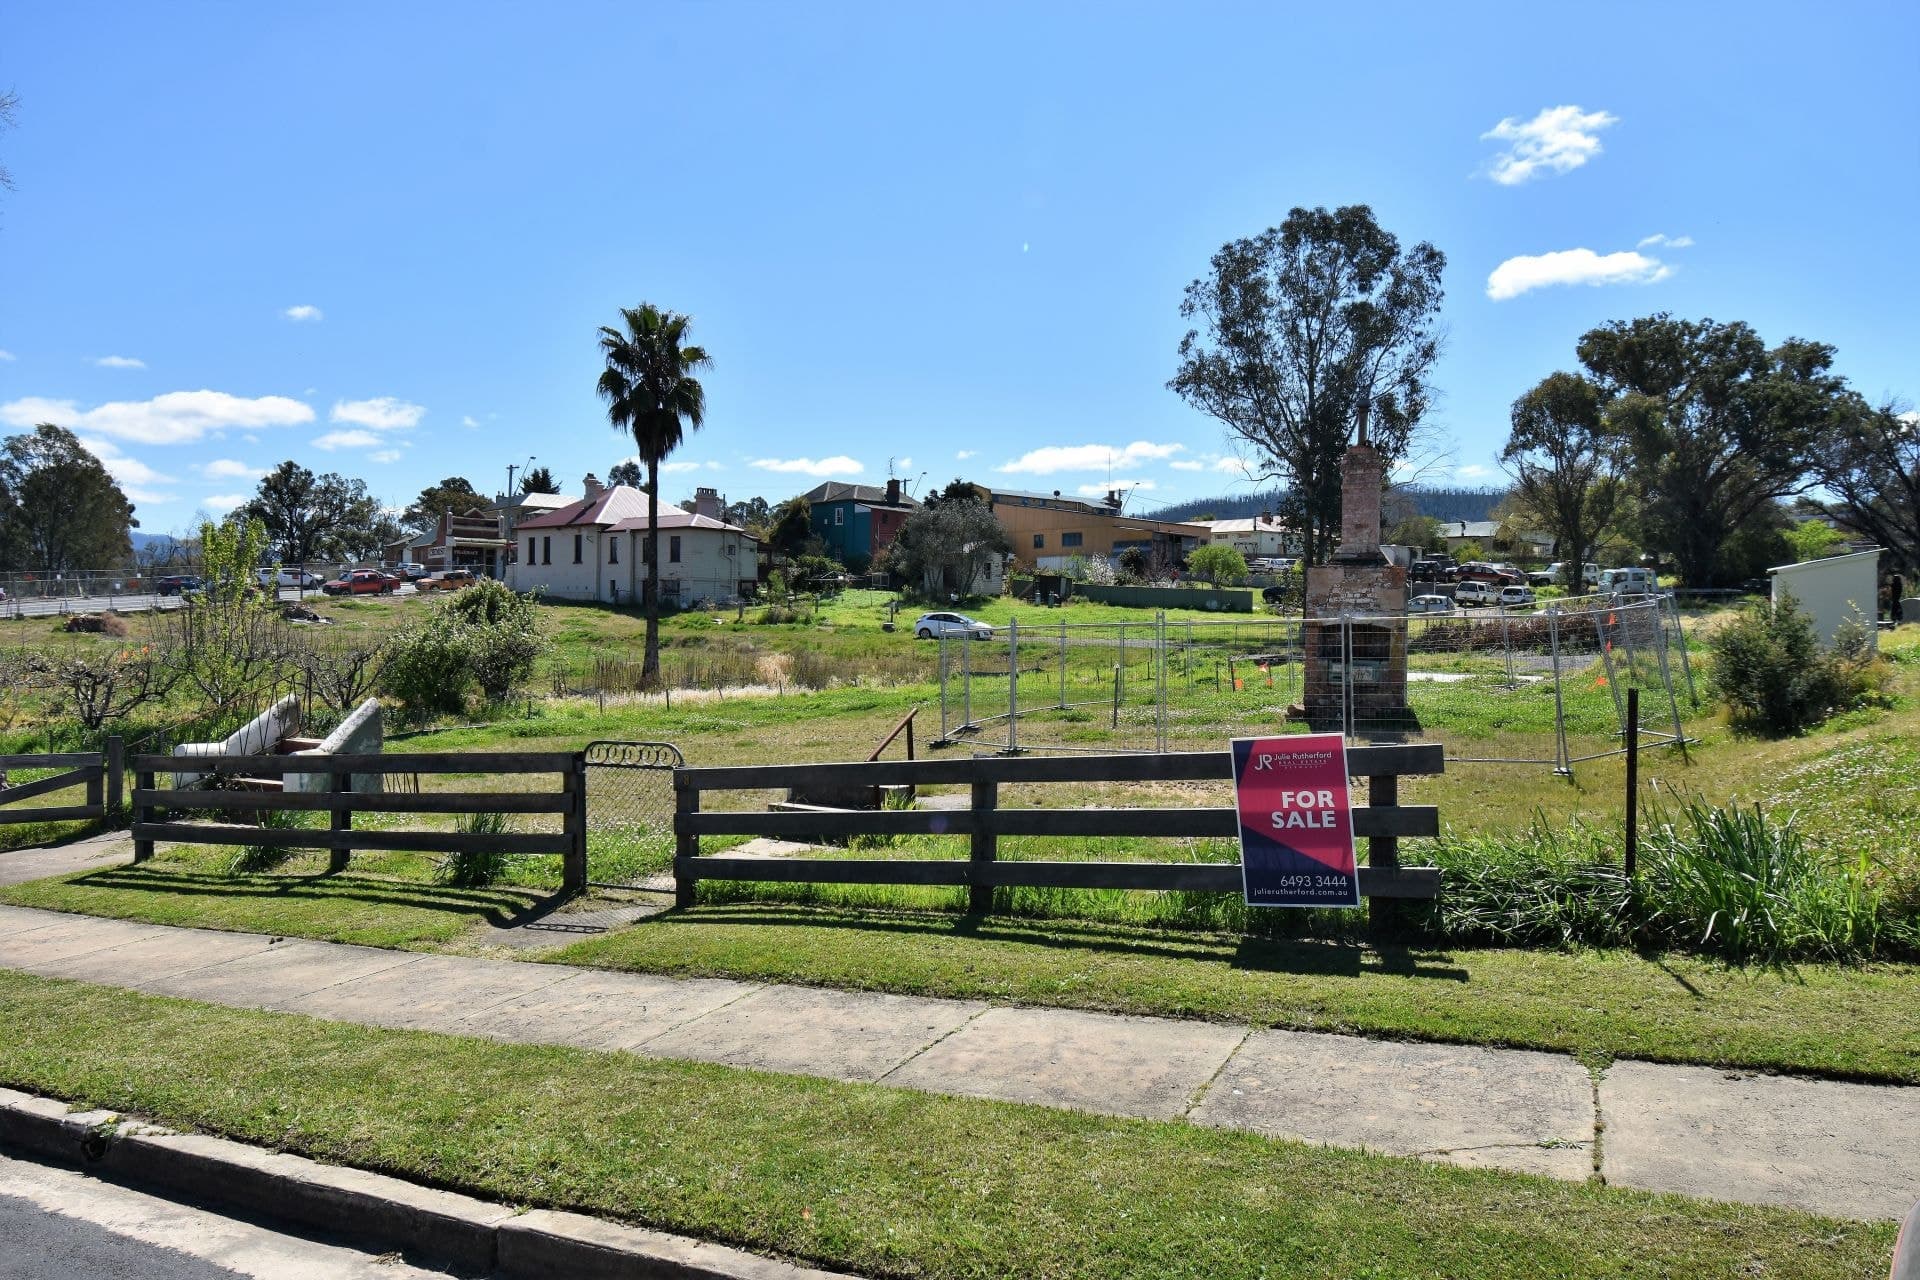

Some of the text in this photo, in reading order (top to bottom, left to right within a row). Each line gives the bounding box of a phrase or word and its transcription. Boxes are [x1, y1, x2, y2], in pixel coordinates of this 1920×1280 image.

[1254, 754, 1273, 771] JR
[1273, 751, 1332, 761] Julie Rutherford
[1281, 790, 1336, 809] FOR
[1271, 810, 1337, 829] SALE
[1280, 875, 1348, 887] 6493 3444
[1254, 887, 1348, 896] julierutherford.com.au
